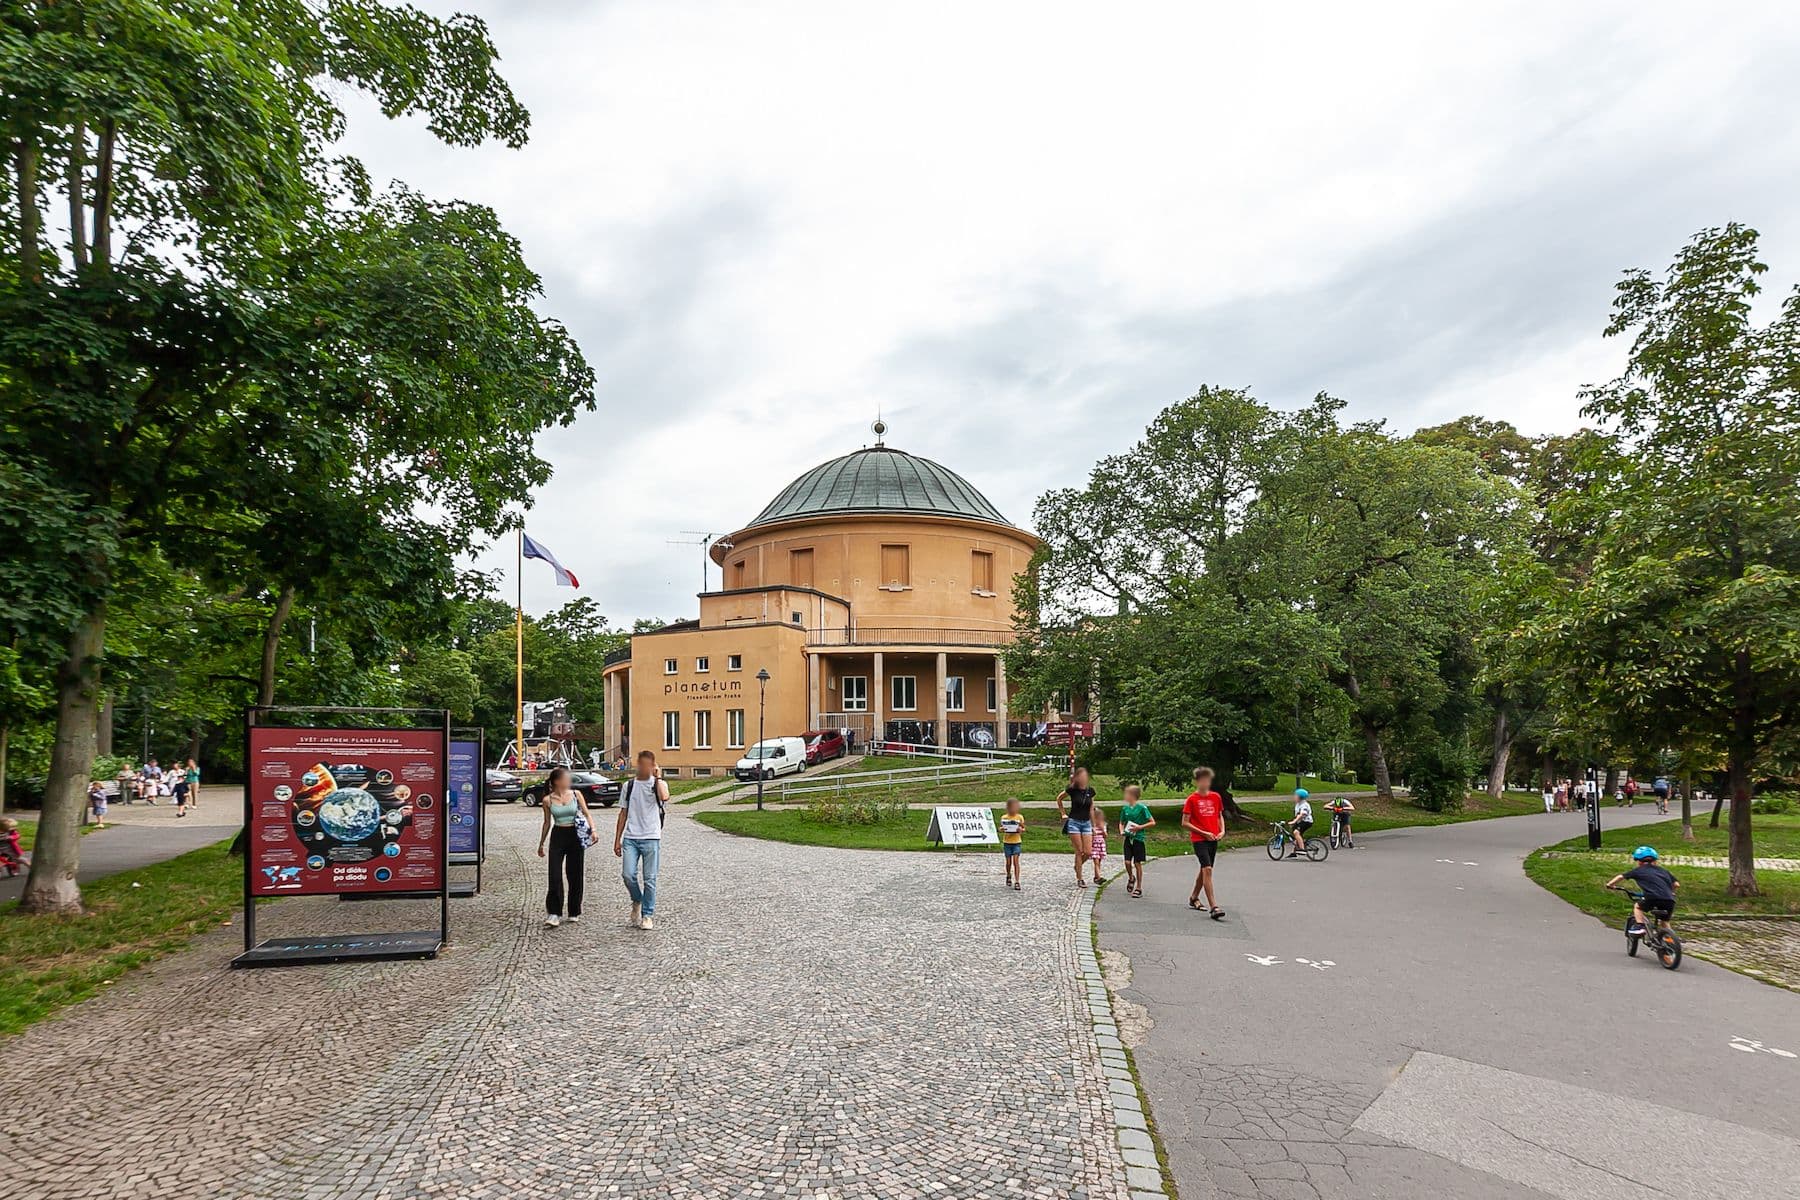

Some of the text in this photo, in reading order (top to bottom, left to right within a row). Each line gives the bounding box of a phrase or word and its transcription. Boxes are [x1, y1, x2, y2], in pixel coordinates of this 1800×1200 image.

[664, 680, 741, 695] planetum
[946, 809, 984, 820] HORSKÁ
[951, 820, 984, 831] DRÁHA
